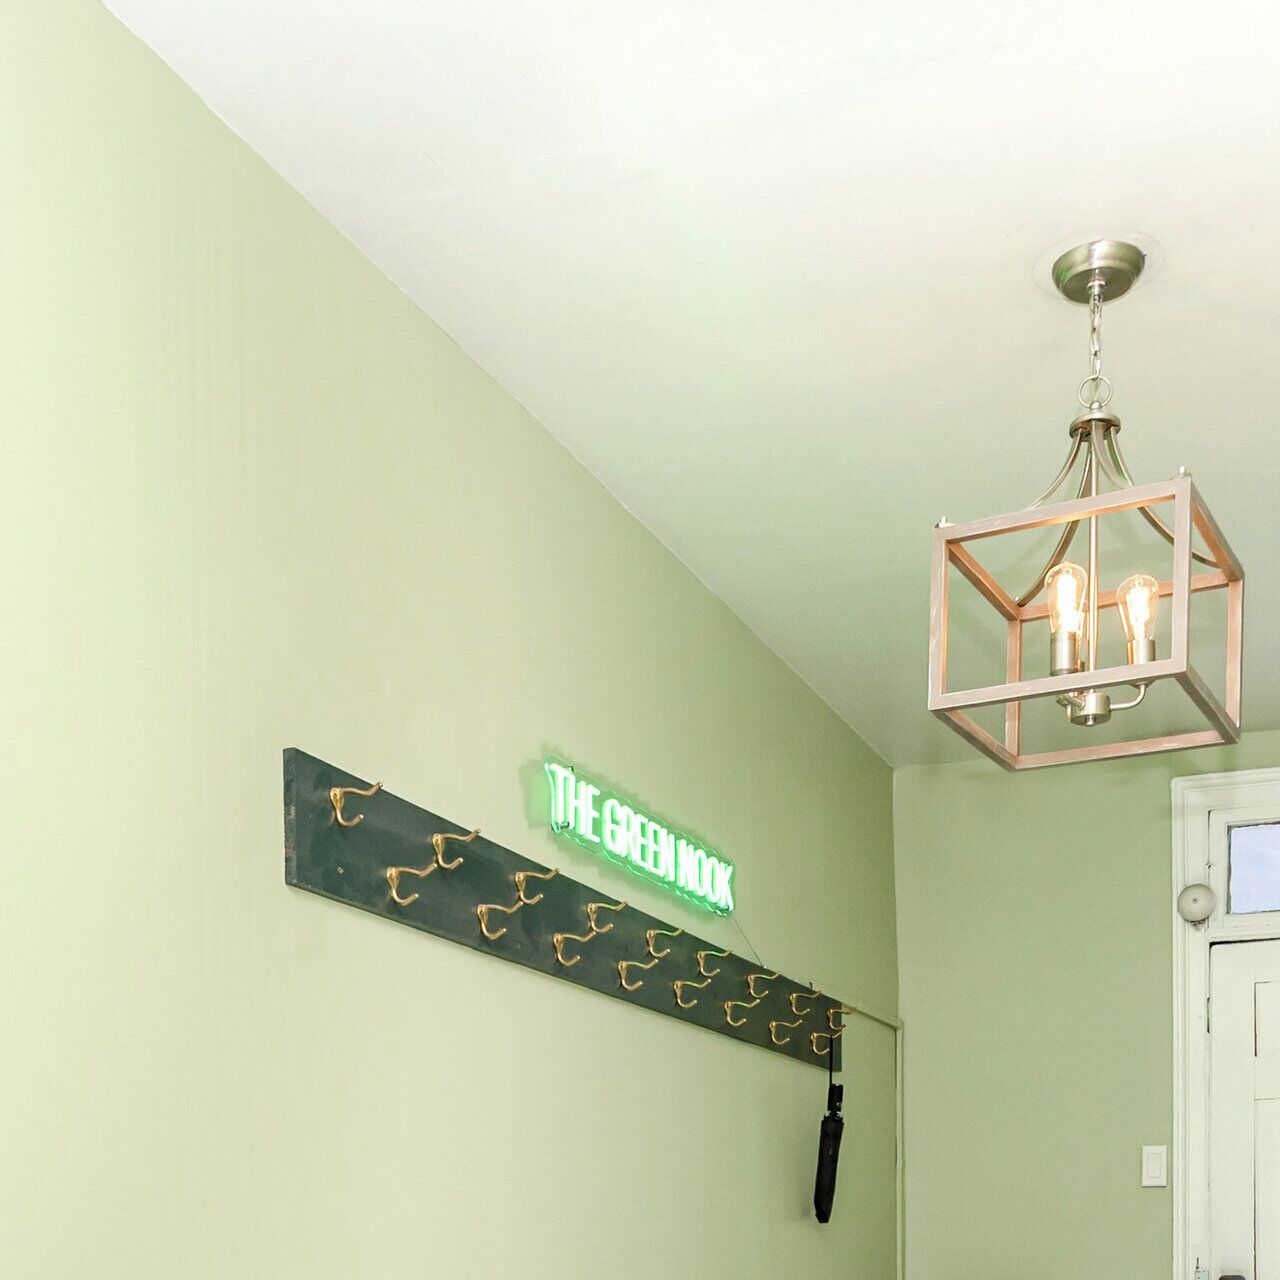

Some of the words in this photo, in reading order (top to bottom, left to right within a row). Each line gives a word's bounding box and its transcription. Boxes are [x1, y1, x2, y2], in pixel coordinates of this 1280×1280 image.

[549, 763, 601, 844] THE
[603, 798, 675, 882] GREEN
[676, 839, 734, 912] NOOK
